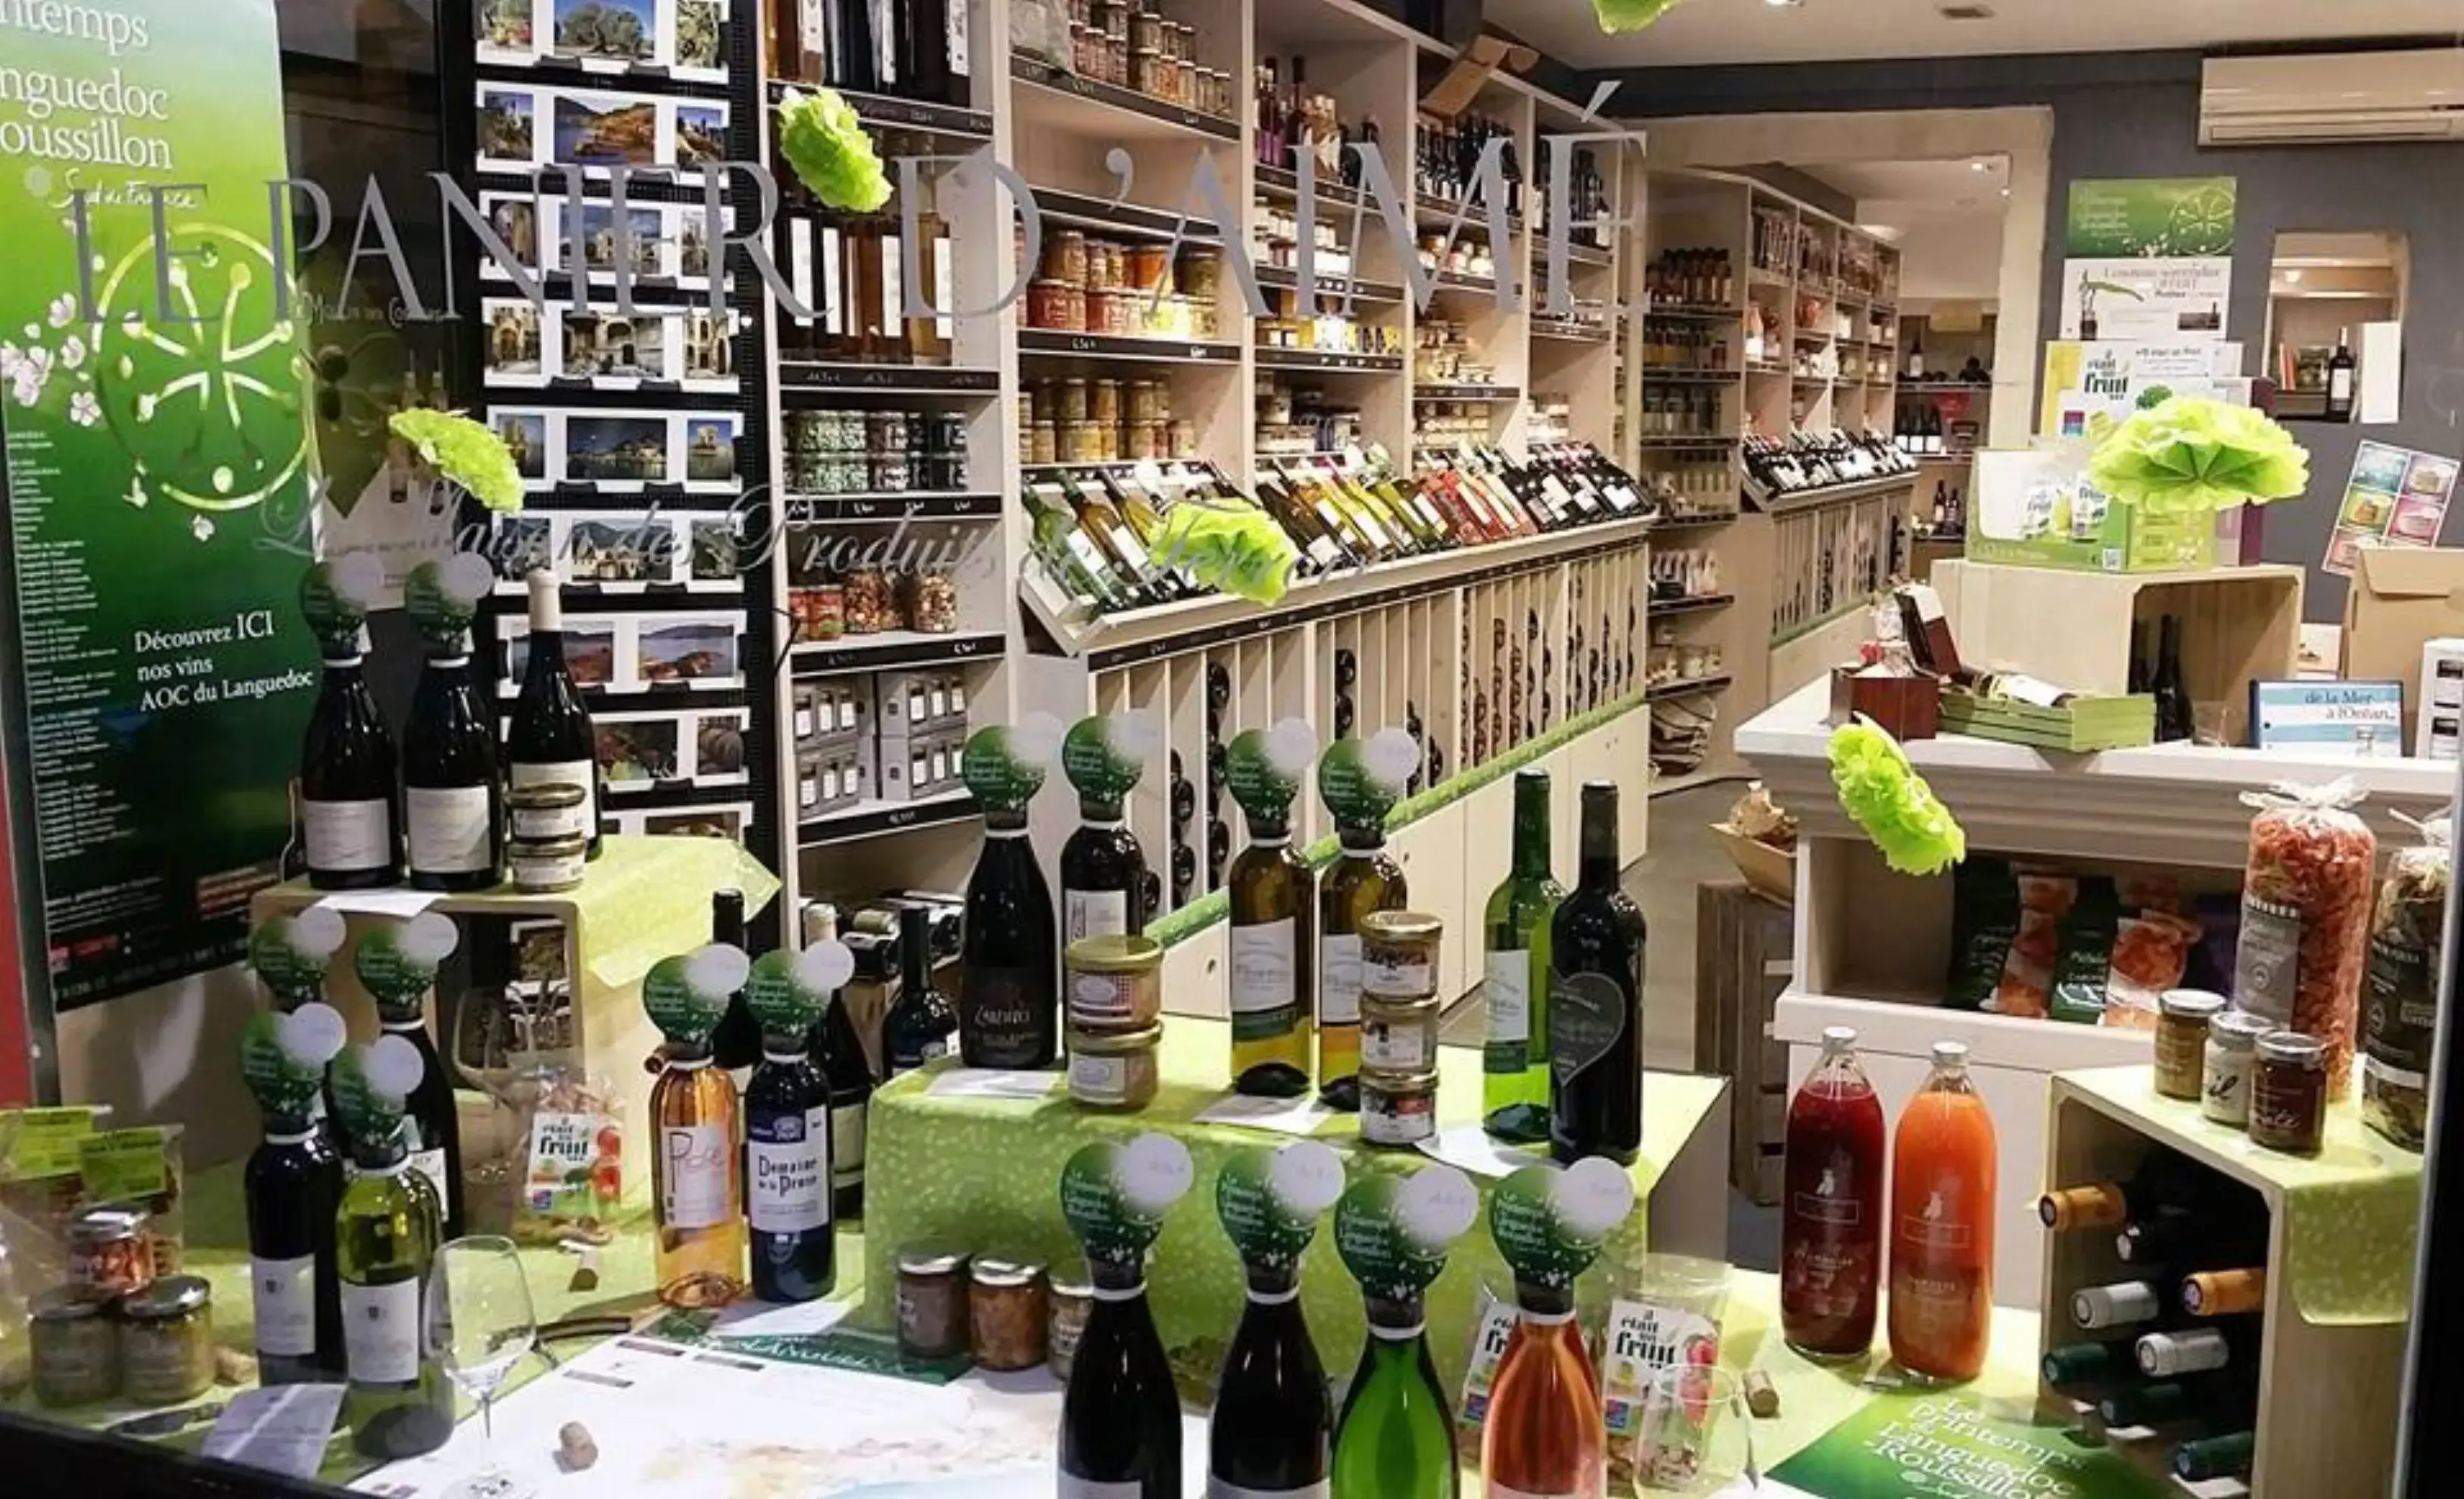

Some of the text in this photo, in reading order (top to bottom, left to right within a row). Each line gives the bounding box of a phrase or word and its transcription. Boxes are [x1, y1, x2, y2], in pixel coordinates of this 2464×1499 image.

[0, 116, 173, 170] oussillon
[67, 184, 222, 323] LE
[266, 160, 833, 322] PANIER
[135, 610, 274, 653] Découvrez ICI
[137, 656, 213, 682] nos vins
[139, 668, 314, 712] AOC du Languedoc
[1615, 1330, 1676, 1365] fruit
